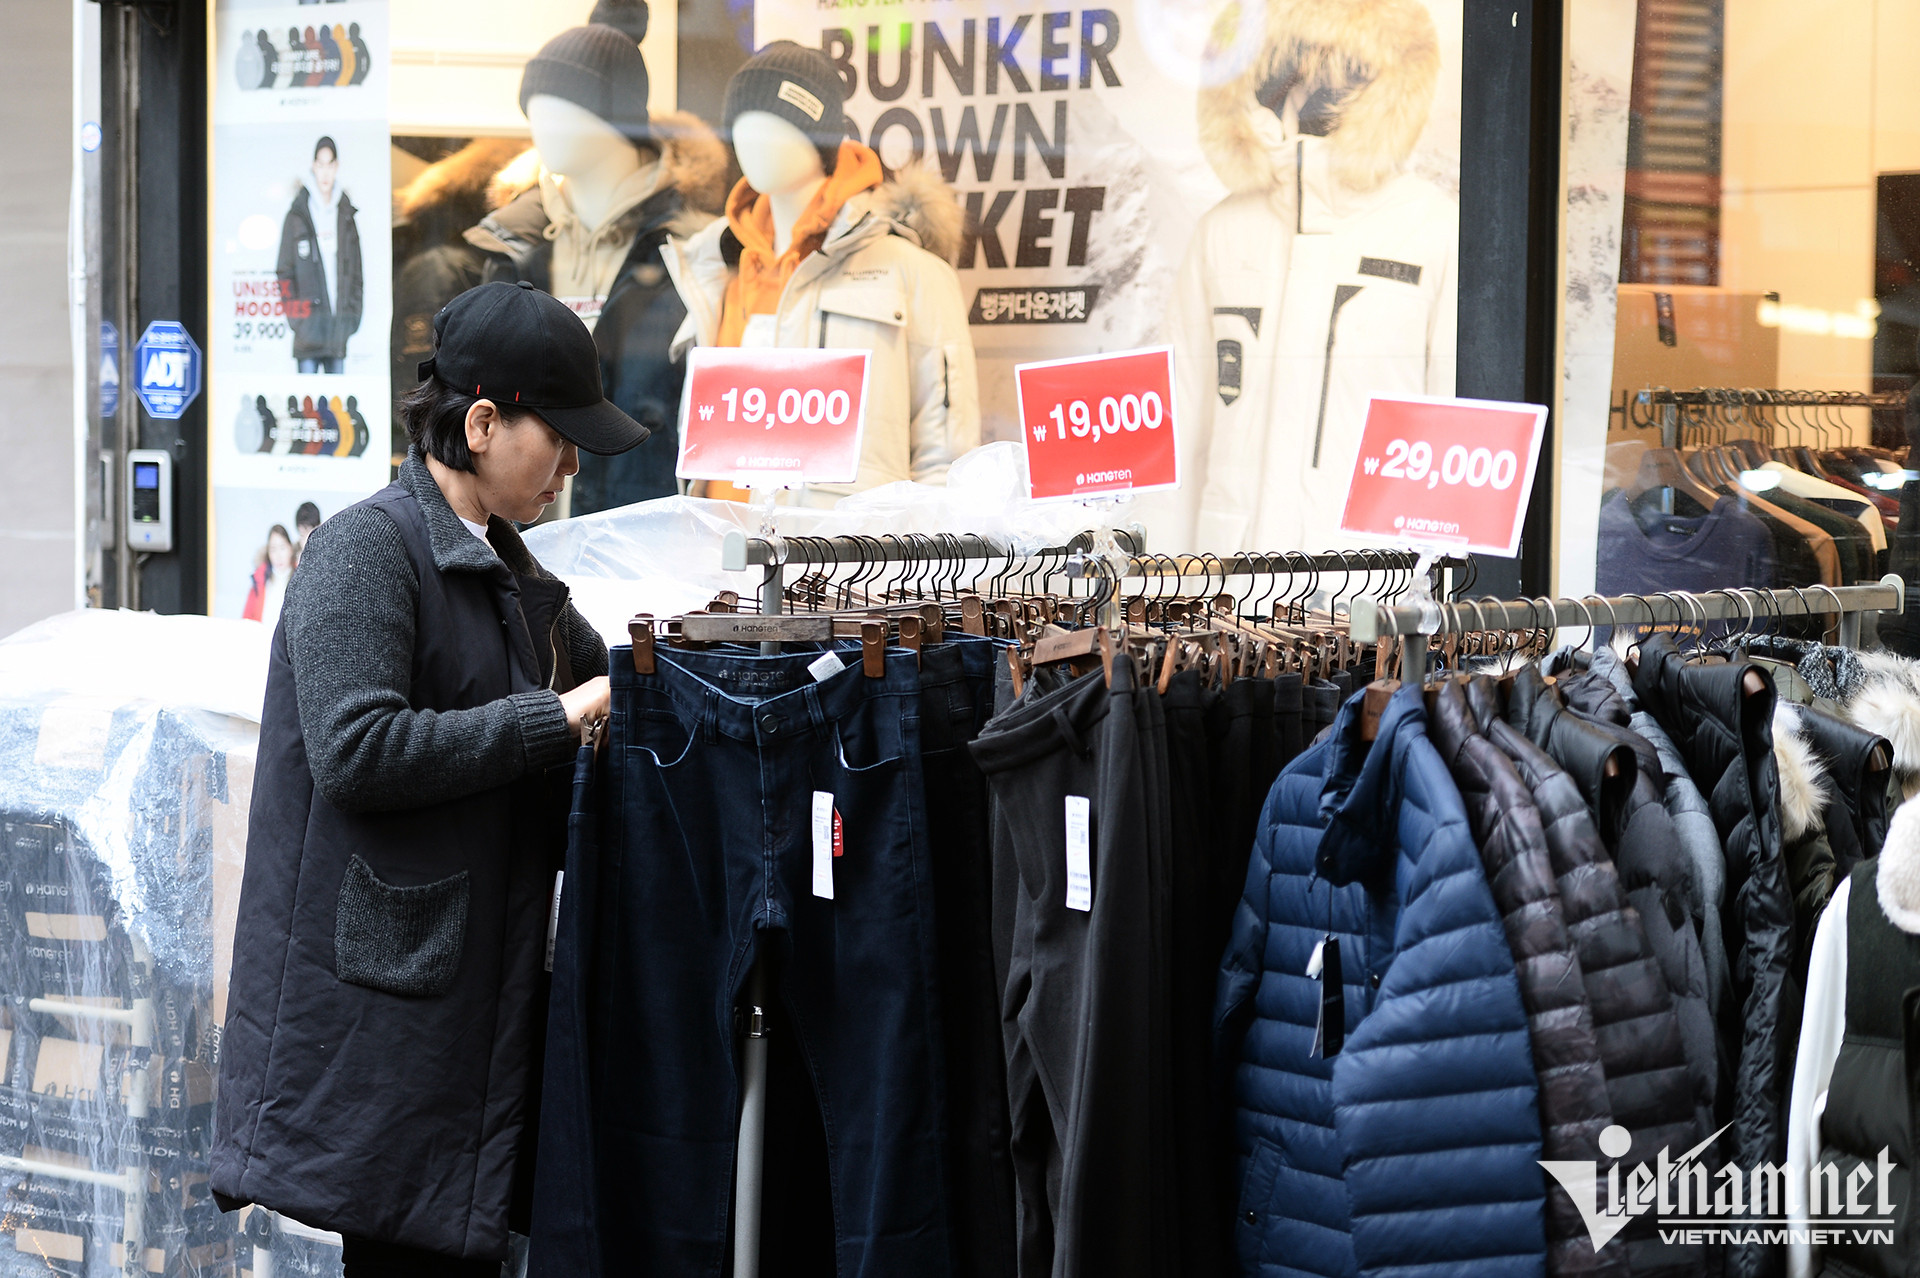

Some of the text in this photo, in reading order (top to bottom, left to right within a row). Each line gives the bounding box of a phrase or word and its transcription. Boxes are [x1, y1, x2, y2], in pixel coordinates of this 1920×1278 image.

[822, 9, 1122, 101] BUNKER
[957, 187, 1106, 269] KET
[233, 279, 292, 297] UNISEX
[235, 300, 312, 318] HOODIES
[980, 291, 1086, 320] 벙커다운자켓
[142, 351, 191, 388] ADT
